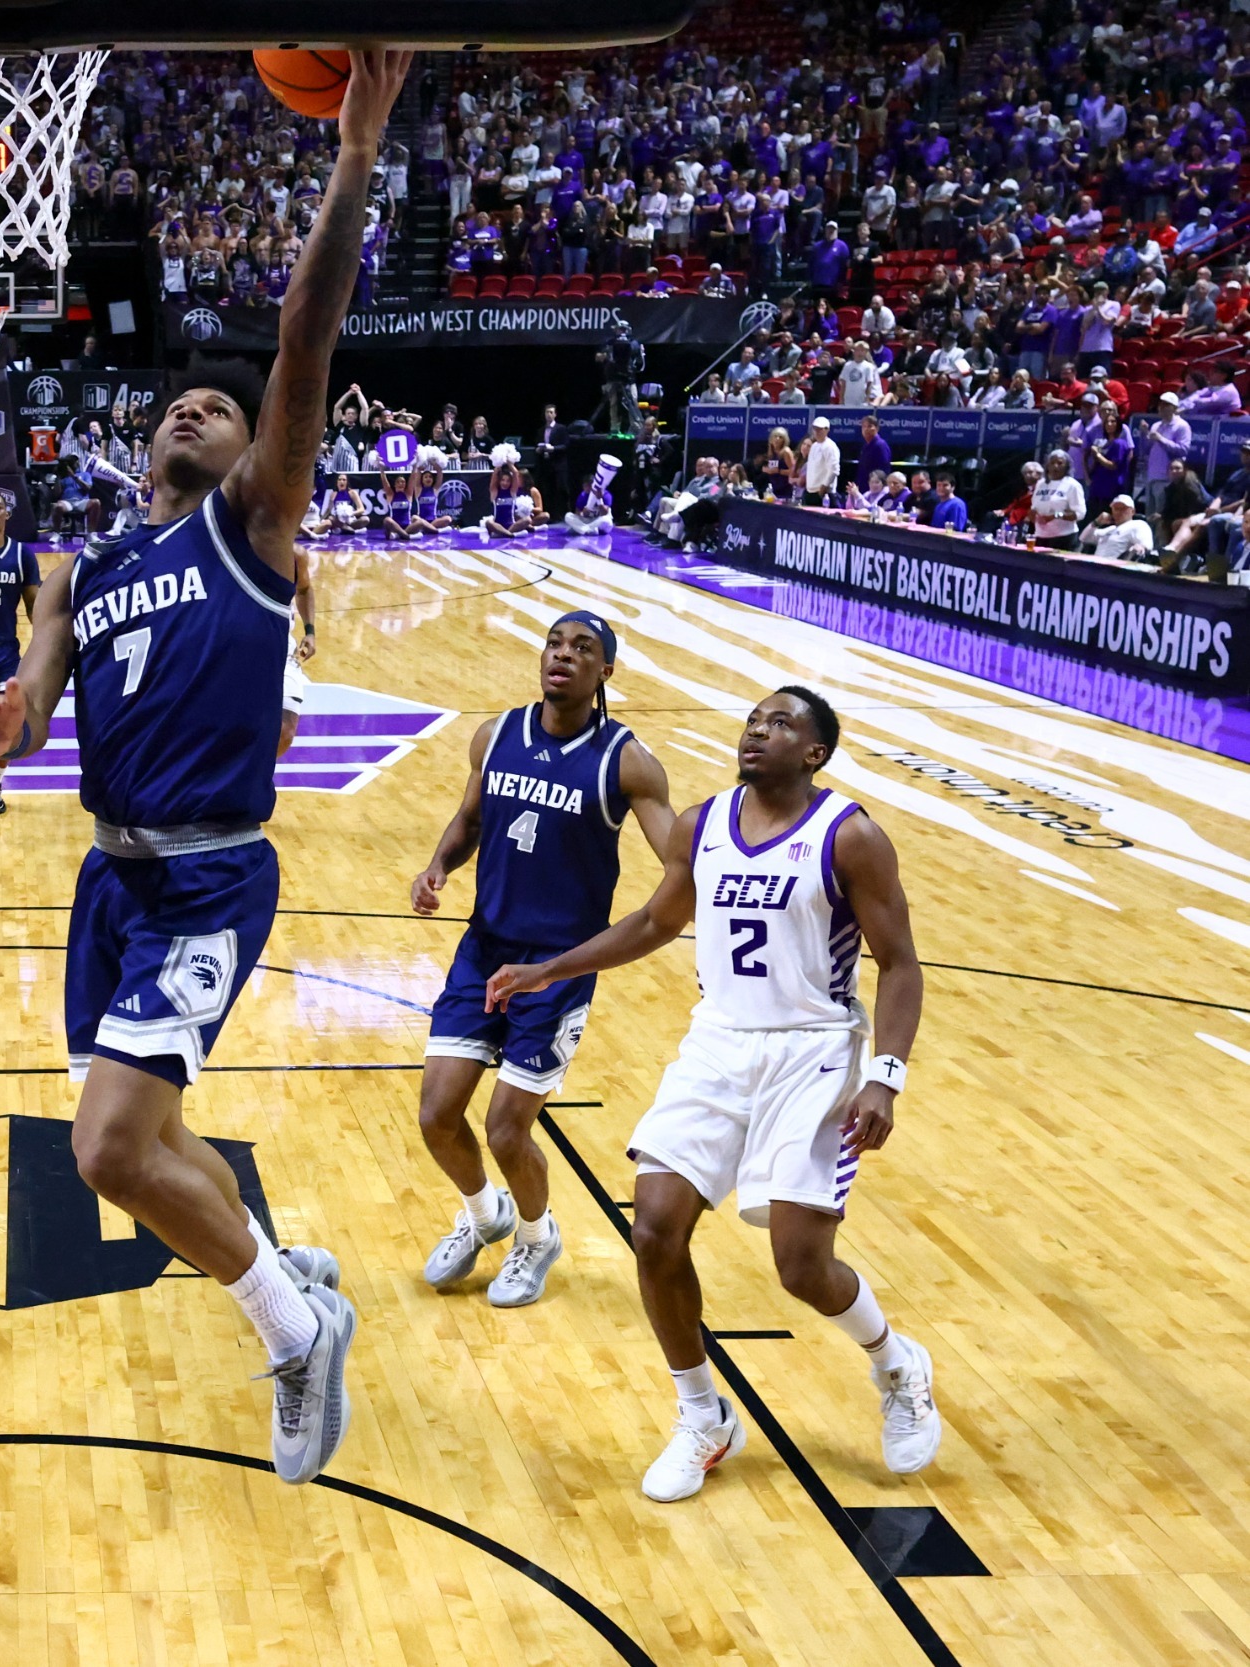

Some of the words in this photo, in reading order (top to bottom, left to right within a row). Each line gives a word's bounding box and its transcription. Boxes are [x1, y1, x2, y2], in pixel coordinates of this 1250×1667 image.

[430, 309, 474, 332] WEST
[478, 307, 621, 331] CHAMPIONSHIPS
[20, 406, 70, 415] CHAMPIONSHIPS
[692, 415, 714, 424] Credit
[716, 416, 739, 424] Union
[752, 416, 775, 425] Credit
[777, 417, 802, 426] Union
[879, 419, 900, 427] Credit
[36, 435, 47, 446] G
[73, 565, 207, 652] NEVADA
[774, 528, 847, 582] MOUNTAIN
[849, 542, 894, 591] WEST
[897, 559, 1011, 625] BASKETBALL
[1017, 584, 1232, 677] CHAMPIONSHIPS
[113, 626, 151, 697] 7
[487, 771, 583, 815] NEVADA
[507, 810, 539, 853] 4
[712, 873, 800, 911] GCU
[730, 918, 768, 978] 2
